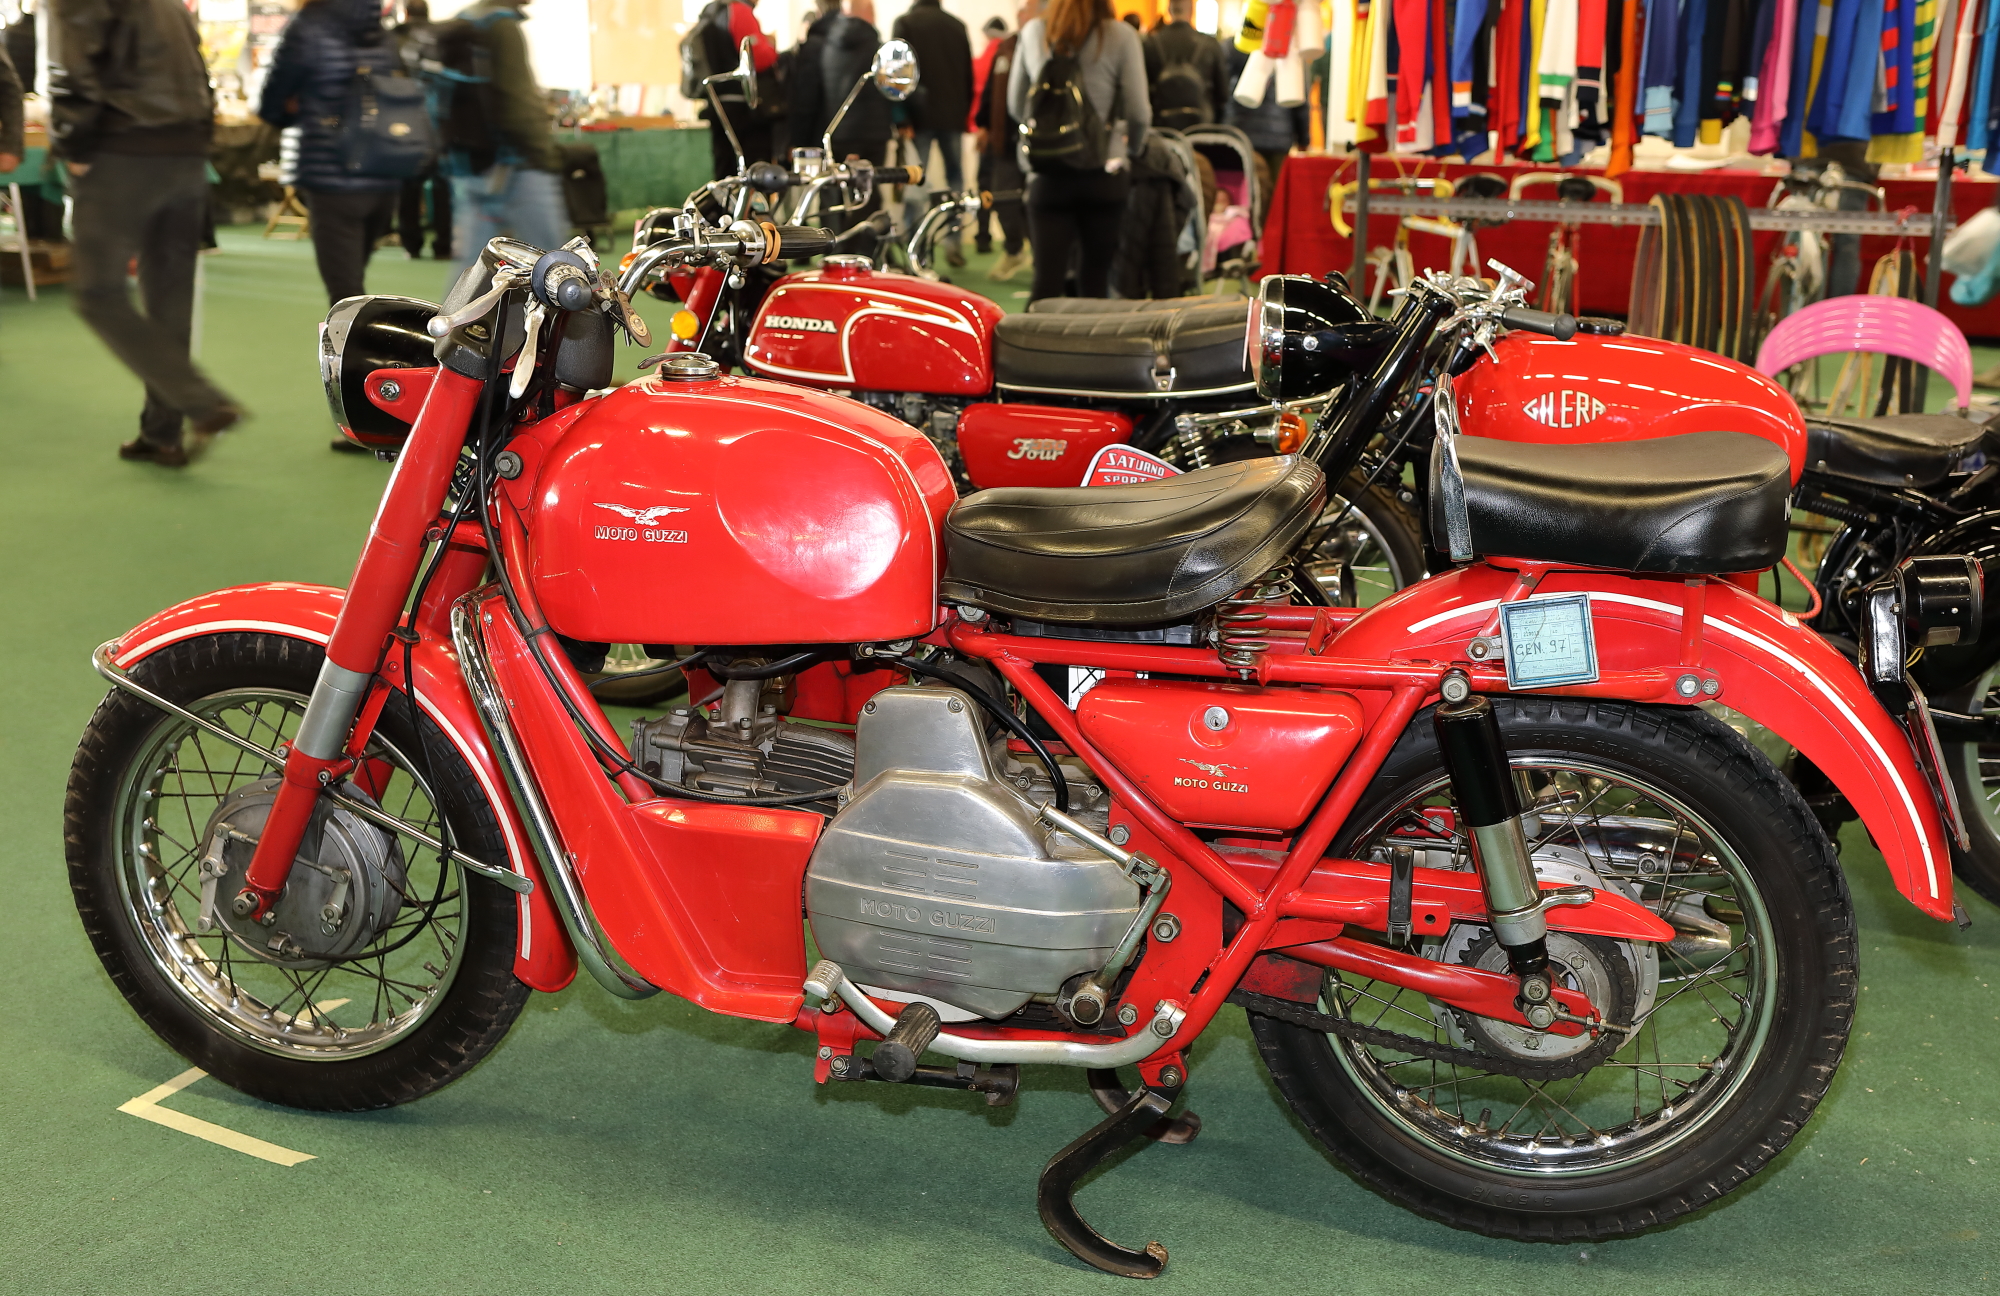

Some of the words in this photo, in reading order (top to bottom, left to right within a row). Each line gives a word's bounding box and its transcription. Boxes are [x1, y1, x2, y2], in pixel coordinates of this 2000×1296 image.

[764, 314, 837, 333] HONDA
[1522, 389, 1607, 429] GILERA
[1007, 438, 1064, 461] Four
[1105, 452, 1165, 477] SATURNO
[1103, 475, 1148, 484] SPORT
[594, 525, 638, 541] MOTO
[642, 528, 688, 543] GUZZI
[1549, 639, 1566, 653] 97
[1174, 776, 1208, 789] MOTO
[1212, 781, 1248, 793] GUZZI
[860, 897, 921, 922] MOTO
[928, 910, 996, 934] GUZZI
